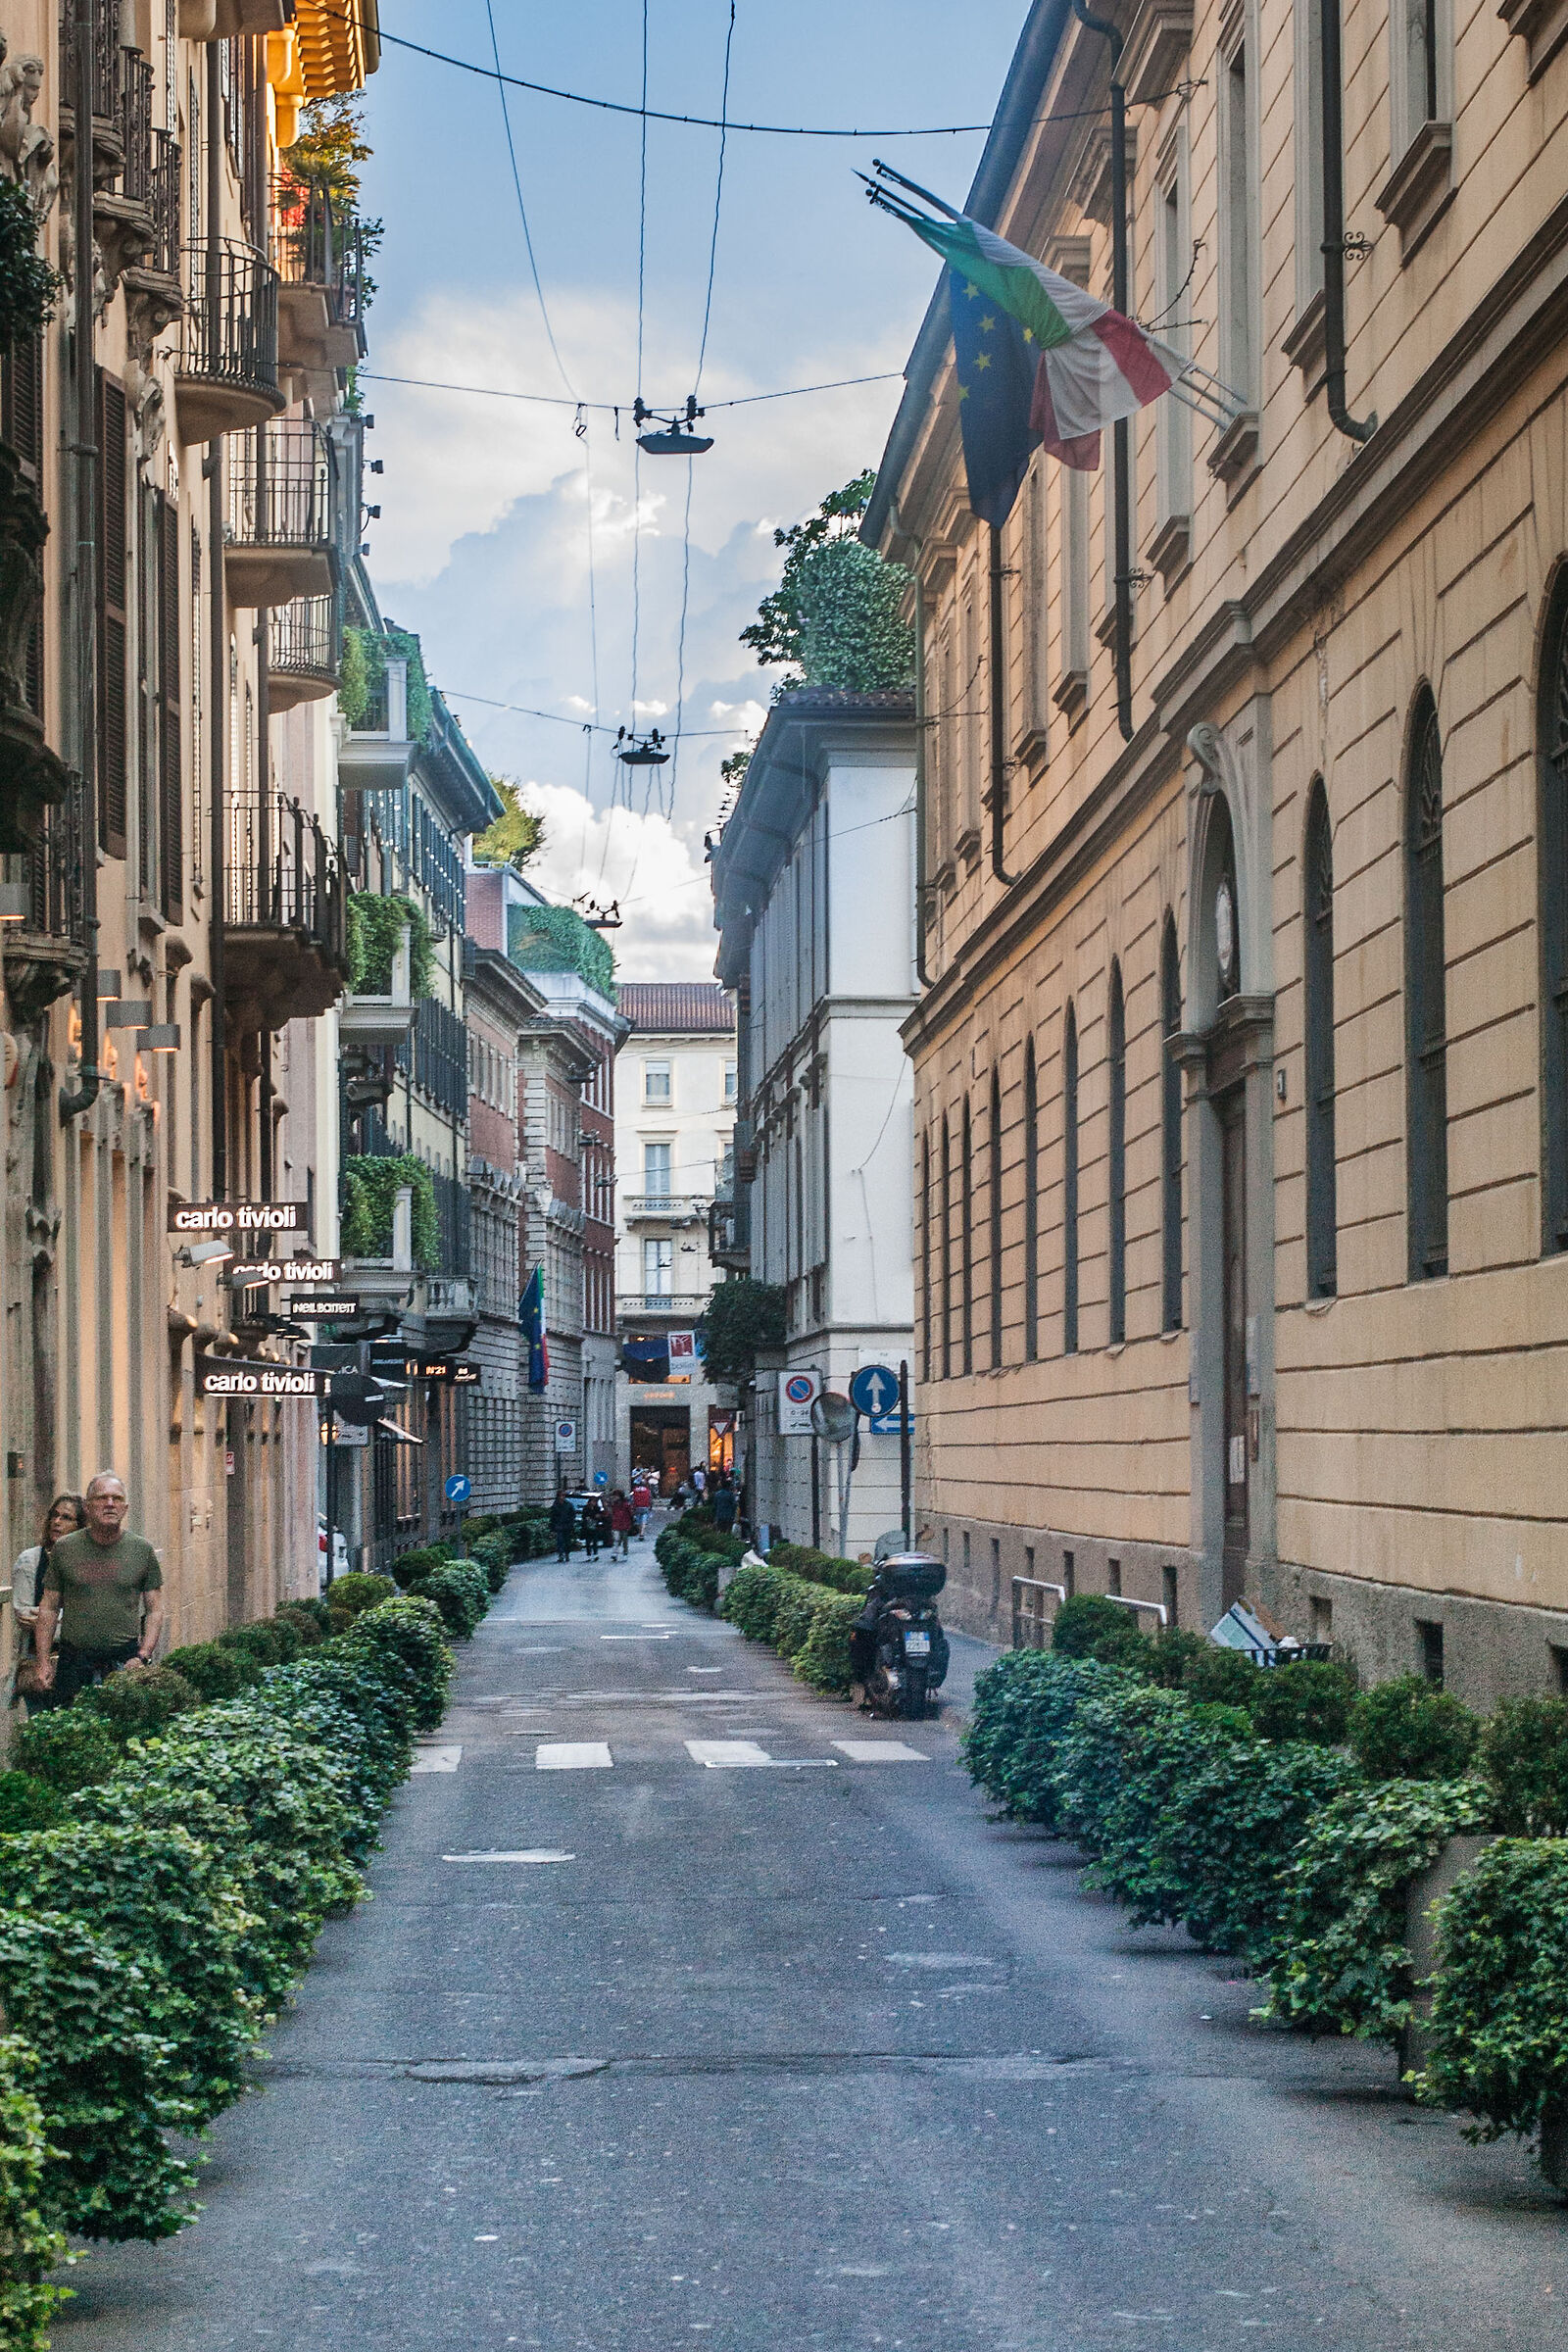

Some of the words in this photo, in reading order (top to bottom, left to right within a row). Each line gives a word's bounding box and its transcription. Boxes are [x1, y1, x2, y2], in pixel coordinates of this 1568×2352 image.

[174, 1205, 234, 1229] carlo
[236, 1205, 297, 1228] tivioli
[283, 1261, 334, 1281] tivioli
[204, 1372, 258, 1392] carlo
[261, 1372, 316, 1393] tivioli
